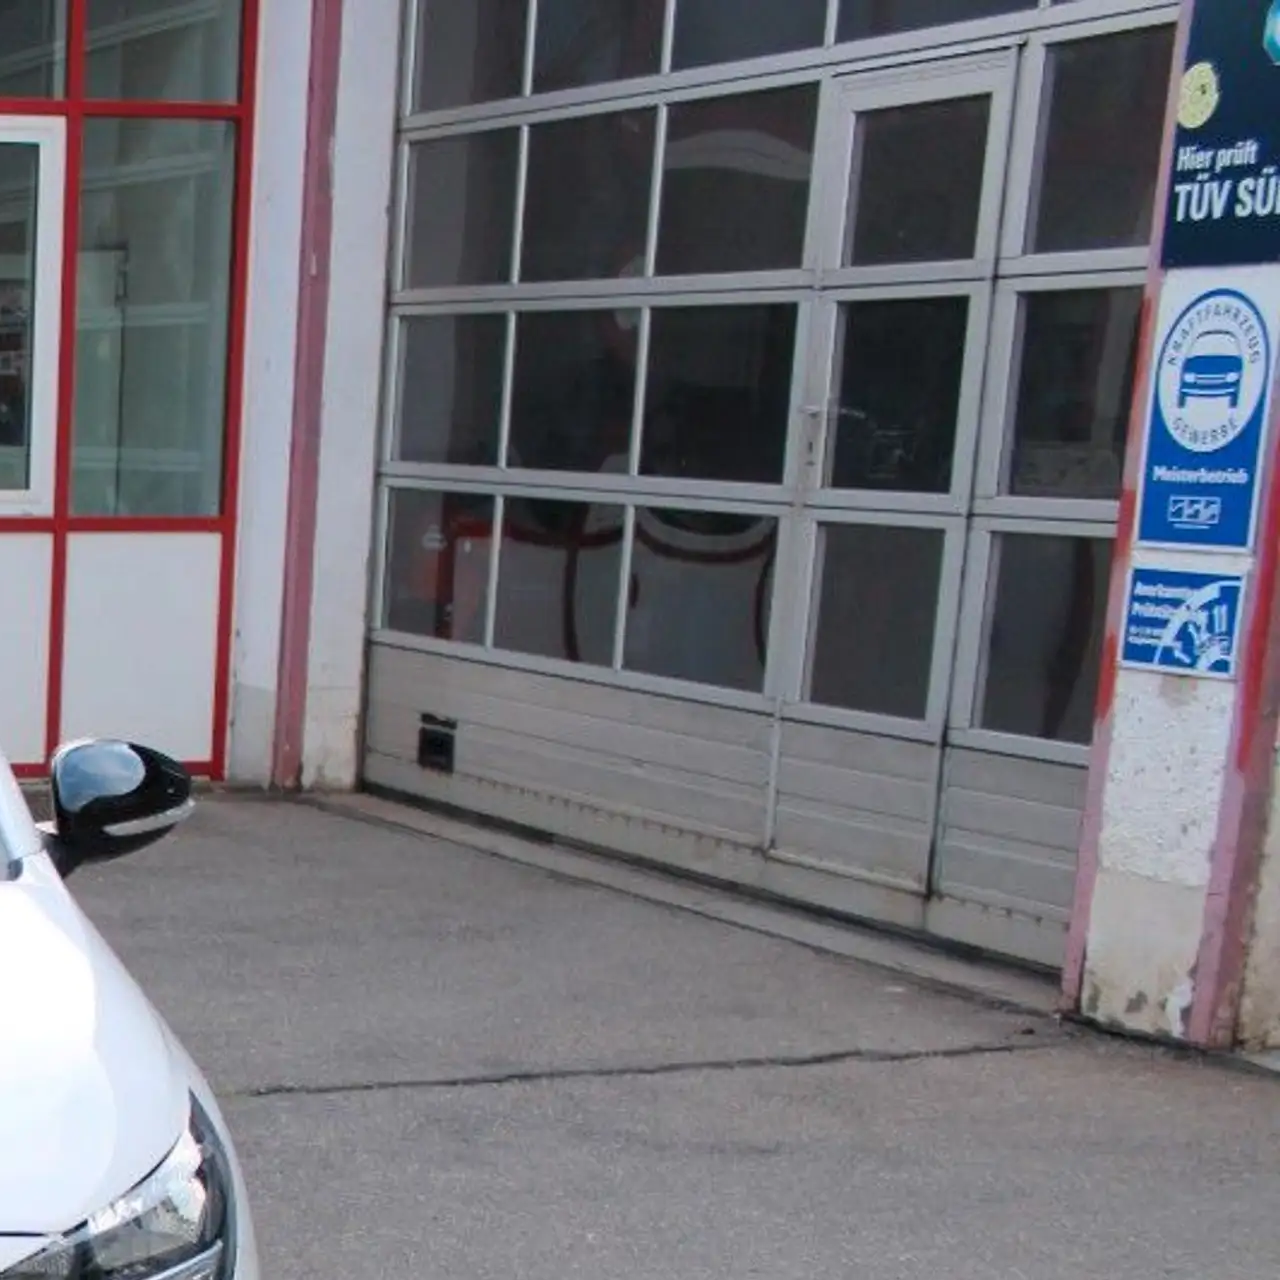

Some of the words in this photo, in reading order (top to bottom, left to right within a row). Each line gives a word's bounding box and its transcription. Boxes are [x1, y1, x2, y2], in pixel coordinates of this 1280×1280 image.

[1176, 145, 1215, 172] Hier
[1215, 139, 1259, 173] prüft
[1174, 172, 1233, 222] TÜV
